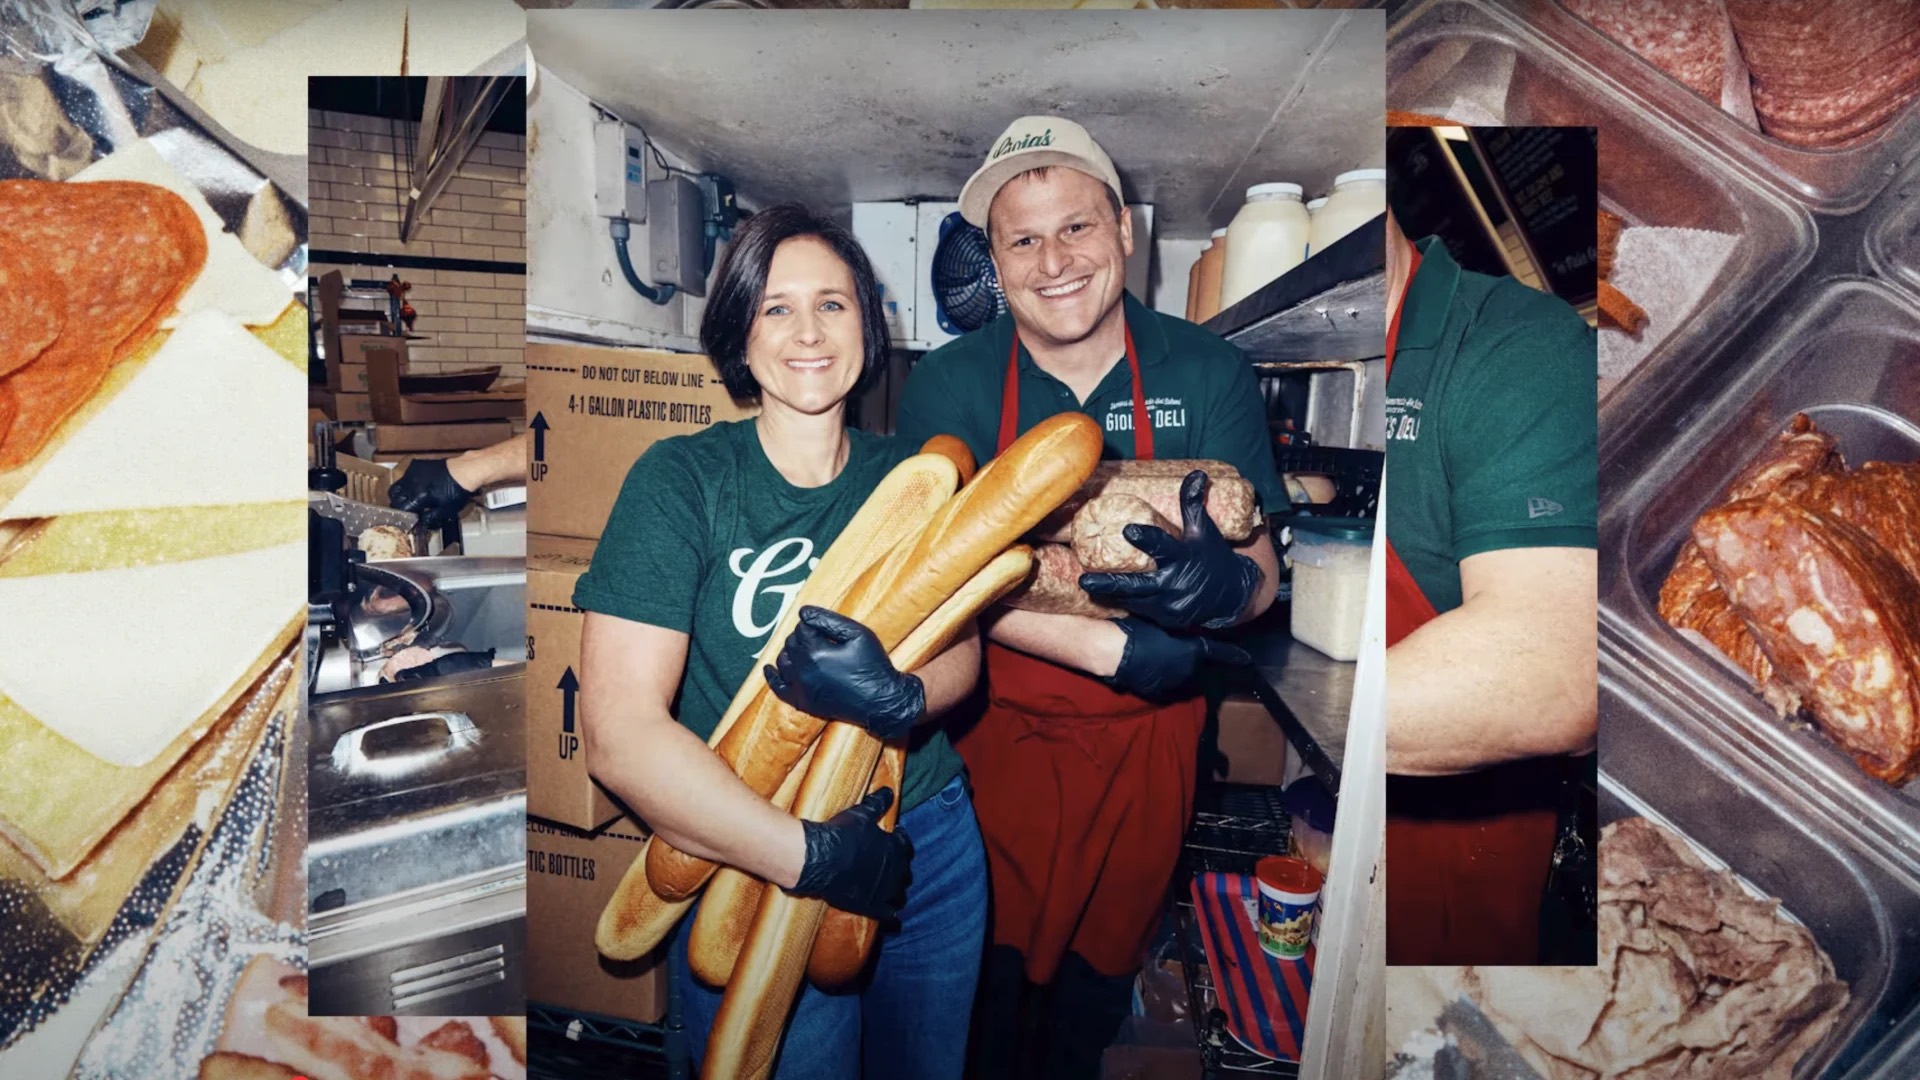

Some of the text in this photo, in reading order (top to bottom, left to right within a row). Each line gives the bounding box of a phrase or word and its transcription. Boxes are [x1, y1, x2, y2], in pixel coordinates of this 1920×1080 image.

[582, 365, 704, 388] DO NOT CUT BELOW LINE
[568, 394, 712, 425] 4-1 GALLON PLASTIC BOTTLES
[1105, 408, 1186, 432] GIOI DELI
[531, 463, 548, 482] UP
[558, 734, 578, 760] UP
[549, 853, 596, 882] BOTTLES
